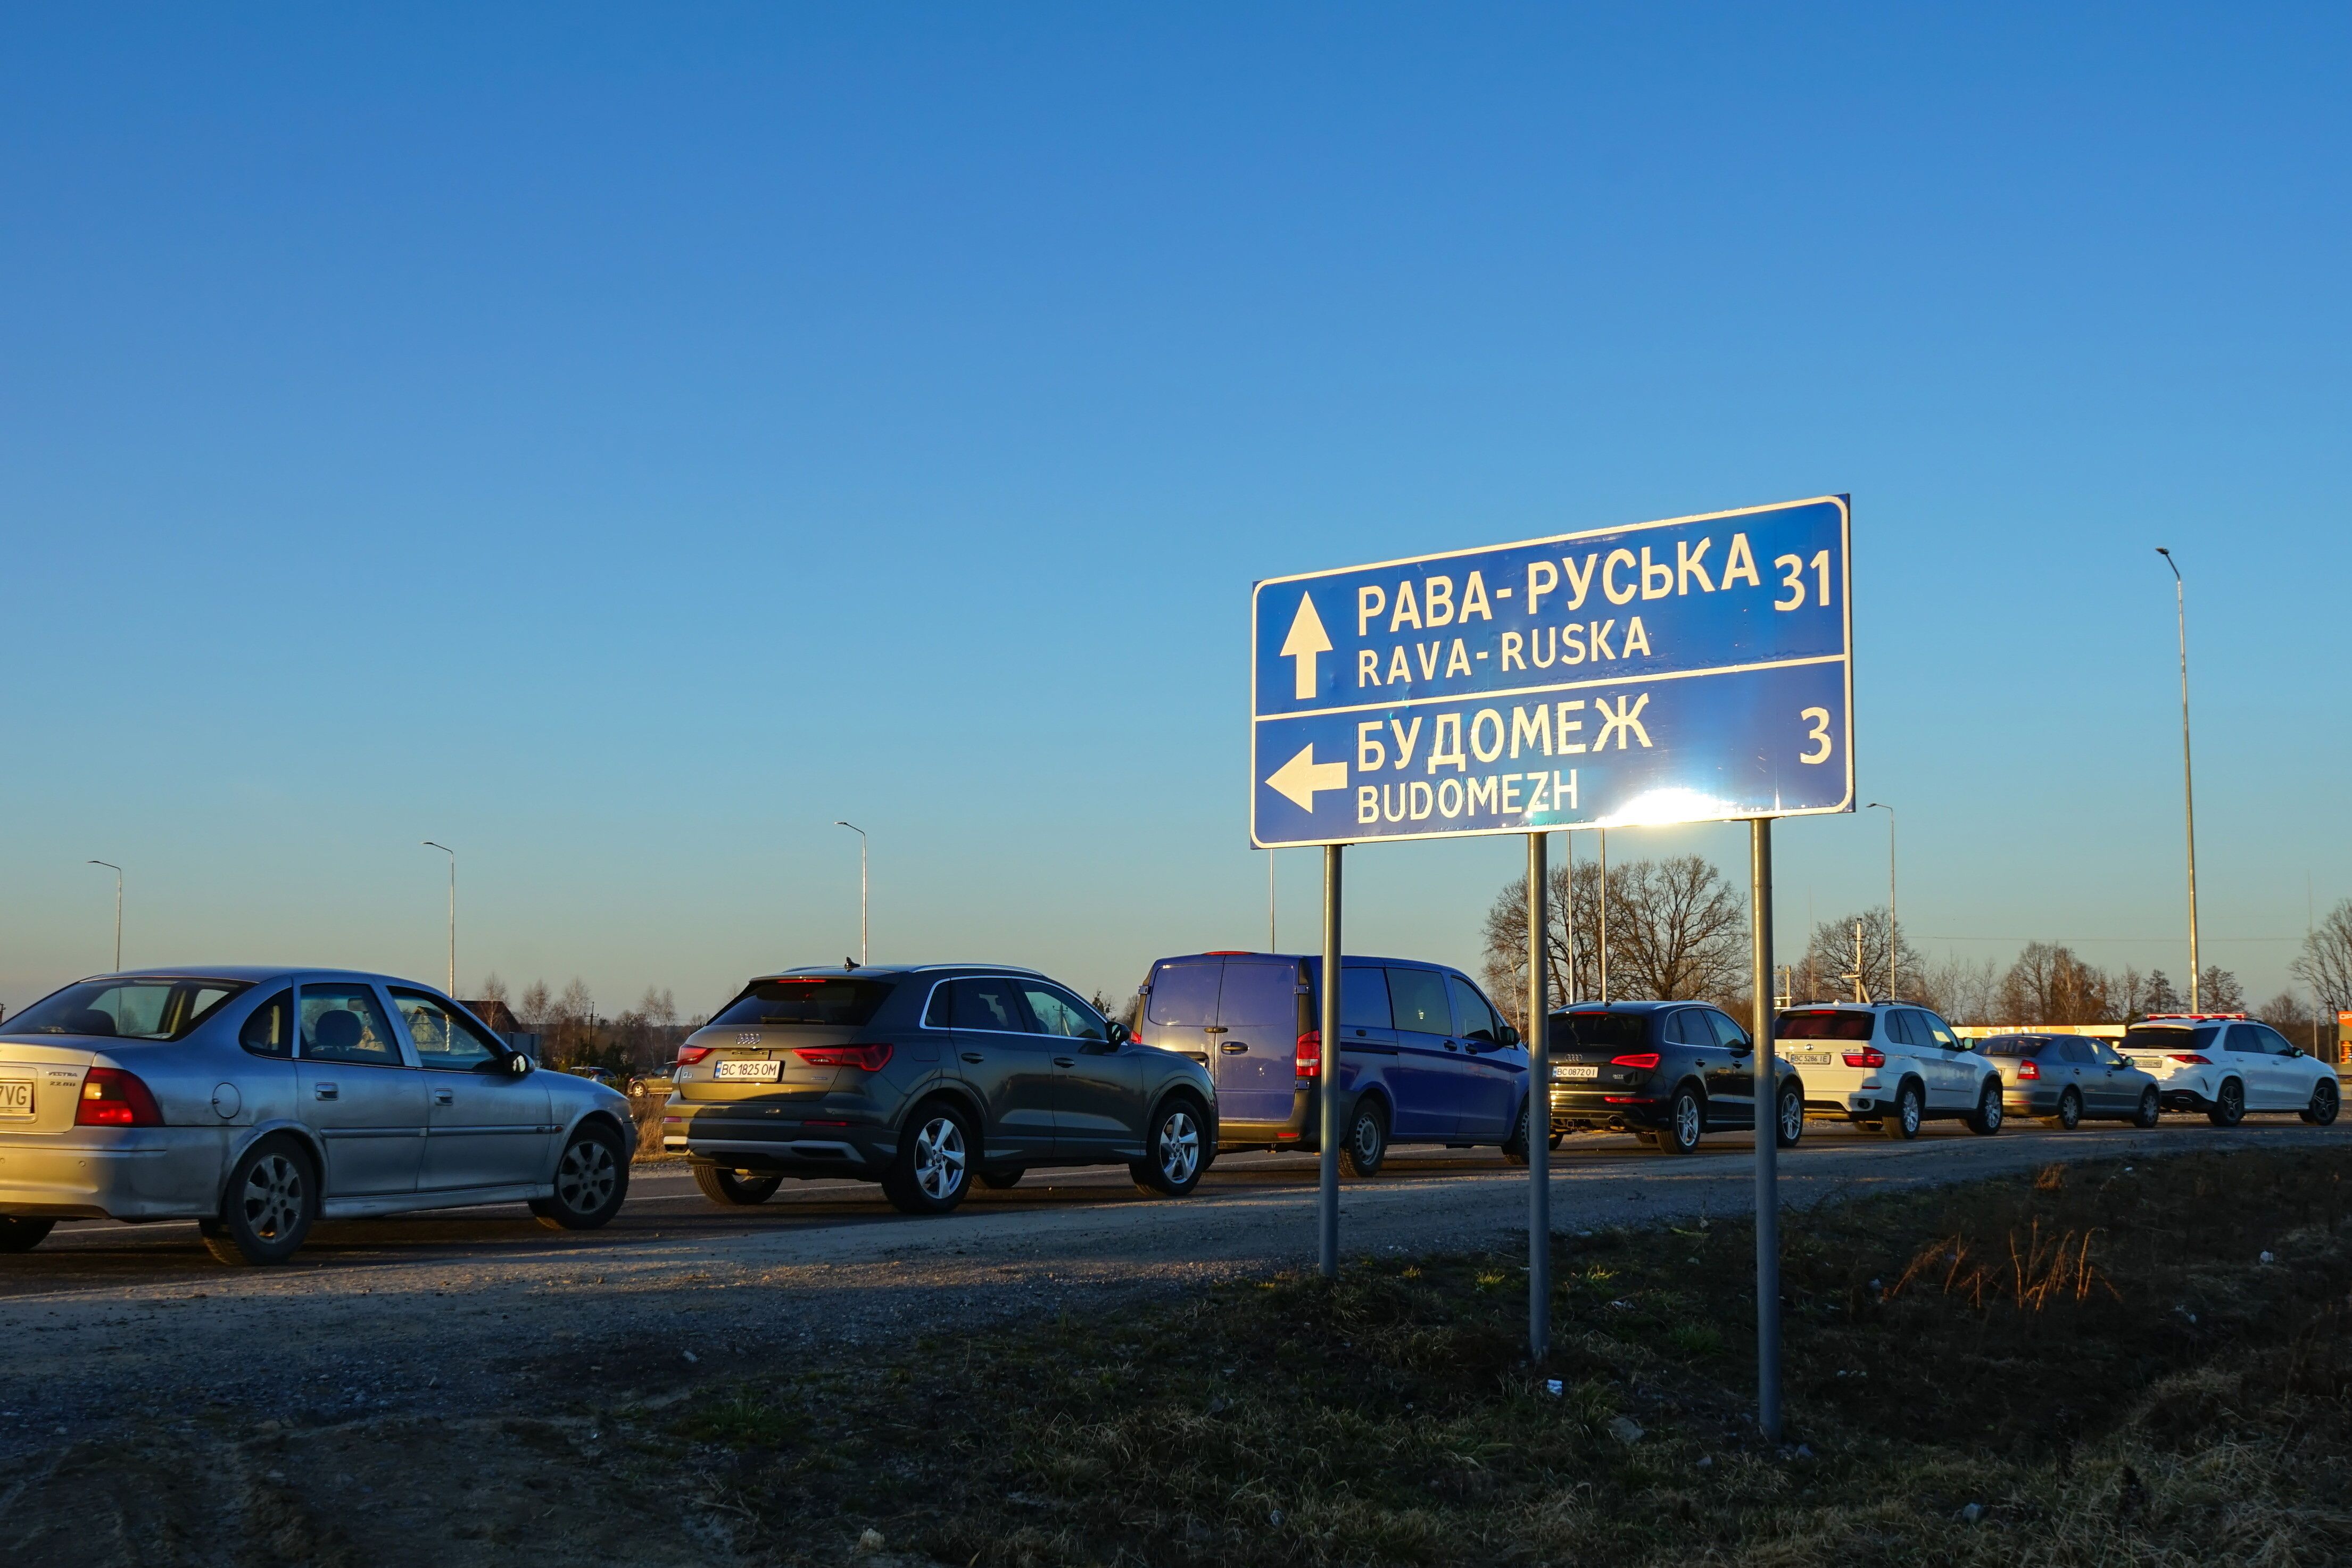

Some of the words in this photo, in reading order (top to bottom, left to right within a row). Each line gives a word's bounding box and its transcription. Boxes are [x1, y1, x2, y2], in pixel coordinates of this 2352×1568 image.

[1774, 550, 1829, 611] 31
[1358, 692, 1654, 775] БУДОМЕЖ
[1800, 707, 1832, 765] 3
[1357, 768, 1578, 825] BUDOMEZH
[721, 1064, 735, 1075] BC
[738, 1064, 759, 1075] 1825
[761, 1064, 776, 1075] OM
